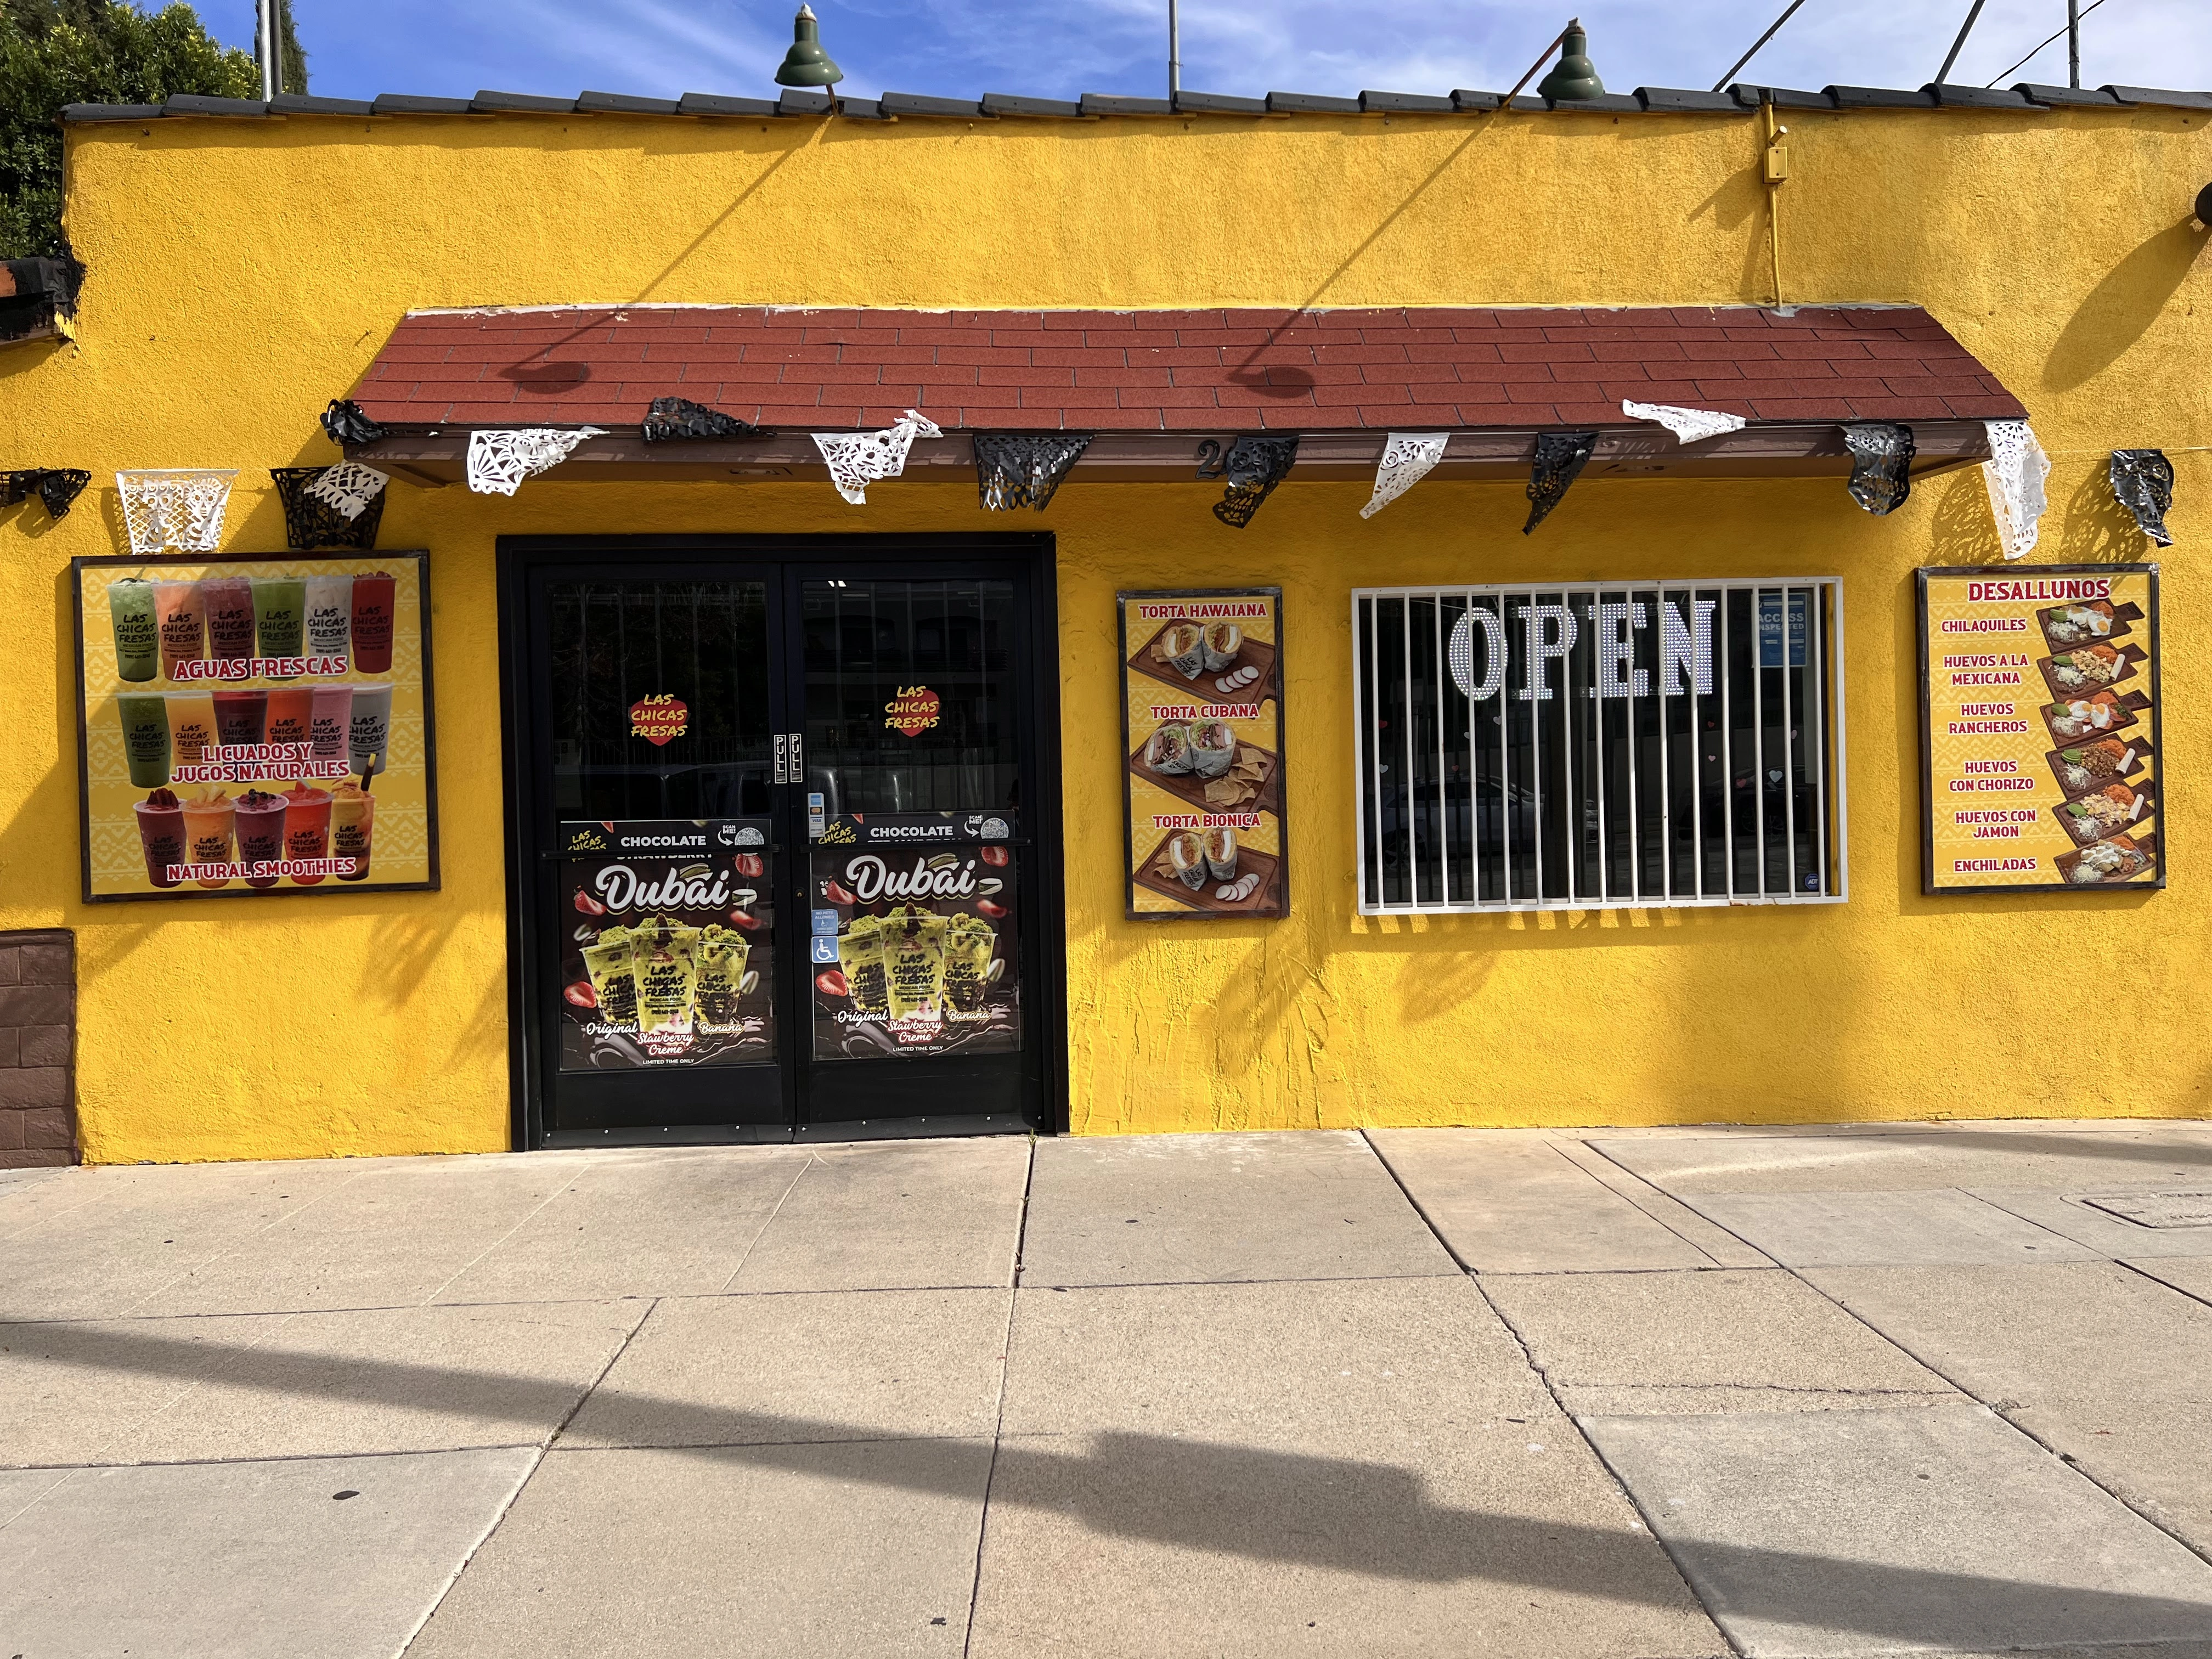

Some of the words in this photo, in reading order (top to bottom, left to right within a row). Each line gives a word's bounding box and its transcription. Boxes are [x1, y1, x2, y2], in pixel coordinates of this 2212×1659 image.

[1968, 579, 2111, 601] DESALLUNOS
[218, 610, 244, 619] LAS
[266, 611, 291, 620] LAS
[314, 608, 338, 617] LAS
[358, 606, 381, 615] LAS
[1139, 605, 1187, 618] TORTA
[1189, 603, 1267, 617] HAWAIANA
[123, 613, 148, 623] LAS
[168, 613, 193, 623] LAS
[308, 617, 346, 627] CHICAS
[353, 616, 389, 625] CHICAS
[1758, 613, 1804, 623] ACCSS
[117, 623, 156, 633] CHICAS
[162, 623, 200, 633] CHICAS
[212, 619, 252, 630] CHICAS
[259, 620, 299, 630] CHICAS
[355, 625, 391, 635] FRESAS
[1941, 619, 2027, 633] CHILAQUILES
[119, 632, 156, 643] FRESAS
[164, 632, 201, 642] FRESAS
[214, 629, 252, 641] FRESAS
[262, 631, 299, 641] FRESAS
[311, 627, 347, 637] FRESAS
[1449, 600, 1716, 701] OPEN
[1944, 656, 1996, 667] HUEVOS
[2000, 655, 2010, 667] A
[2011, 654, 2028, 666] LA
[174, 659, 246, 679] AGUAS
[251, 657, 347, 677] FRESCAS
[1952, 673, 2021, 685] MEXICANA
[897, 685, 926, 697] LAS
[644, 694, 674, 705] LAS
[885, 701, 939, 713] CHICAS
[1150, 706, 1198, 718] TORTA
[1200, 704, 1259, 718] CUBANA
[1961, 703, 2013, 715] HUEVOS
[353, 716, 377, 725] LAS
[631, 709, 687, 721] CHICAS
[885, 716, 940, 729] FRESAS
[1949, 721, 2027, 733] RANCHEROS
[311, 726, 341, 734] HICAS
[349, 724, 385, 735] HICAS
[631, 725, 688, 737] FRESAS
[132, 740, 166, 748] FRESAS
[178, 739, 210, 747] FRESAS
[272, 734, 304, 743] FRESAS
[204, 744, 296, 761] LICUADOS
[298, 743, 313, 759] Y
[776, 737, 785, 772] PULL
[791, 735, 800, 770] PULL
[171, 766, 235, 782] JUGOS
[239, 761, 350, 780] NATURALES
[1965, 761, 2017, 773] HUEVOS
[1950, 780, 1974, 791] CON
[1977, 778, 2034, 791] CHORIZO
[1153, 815, 1199, 828] TORTA
[1203, 814, 1261, 827] BIONICA
[1956, 811, 2007, 823] HUEVOS
[2011, 810, 2036, 822] CON
[825, 821, 841, 834] AS
[870, 826, 953, 838] CHOCOLATE
[1973, 826, 2019, 838] JAMON
[289, 837, 321, 845] CHICAS
[572, 830, 590, 844] LAS
[818, 826, 851, 844] CHICAS
[620, 836, 706, 847] CHOCOLATE
[291, 844, 323, 852] FRESAS
[168, 862, 251, 880] NATURAL
[255, 858, 356, 877] SMOOTHIES
[1955, 859, 2036, 871] ENCHILADAS
[846, 855, 976, 899] Dubai
[595, 865, 730, 910] Dubai
[900, 954, 926, 964] LAS
[651, 966, 676, 975] LAS
[893, 964, 933, 974] CHICAS
[643, 975, 685, 986] CHICAS
[895, 974, 935, 985] FRESAS
[645, 986, 686, 997] FRESAS
[838, 1009, 888, 1027] Original
[947, 1009, 990, 1020] Banana
[586, 1021, 637, 1039] Original
[699, 1022, 743, 1033] Banana
[888, 1020, 943, 1034] Stawberry
[638, 1032, 695, 1047] Stawberry
[899, 1031, 933, 1043] Creme
[649, 1044, 684, 1056] Creme
